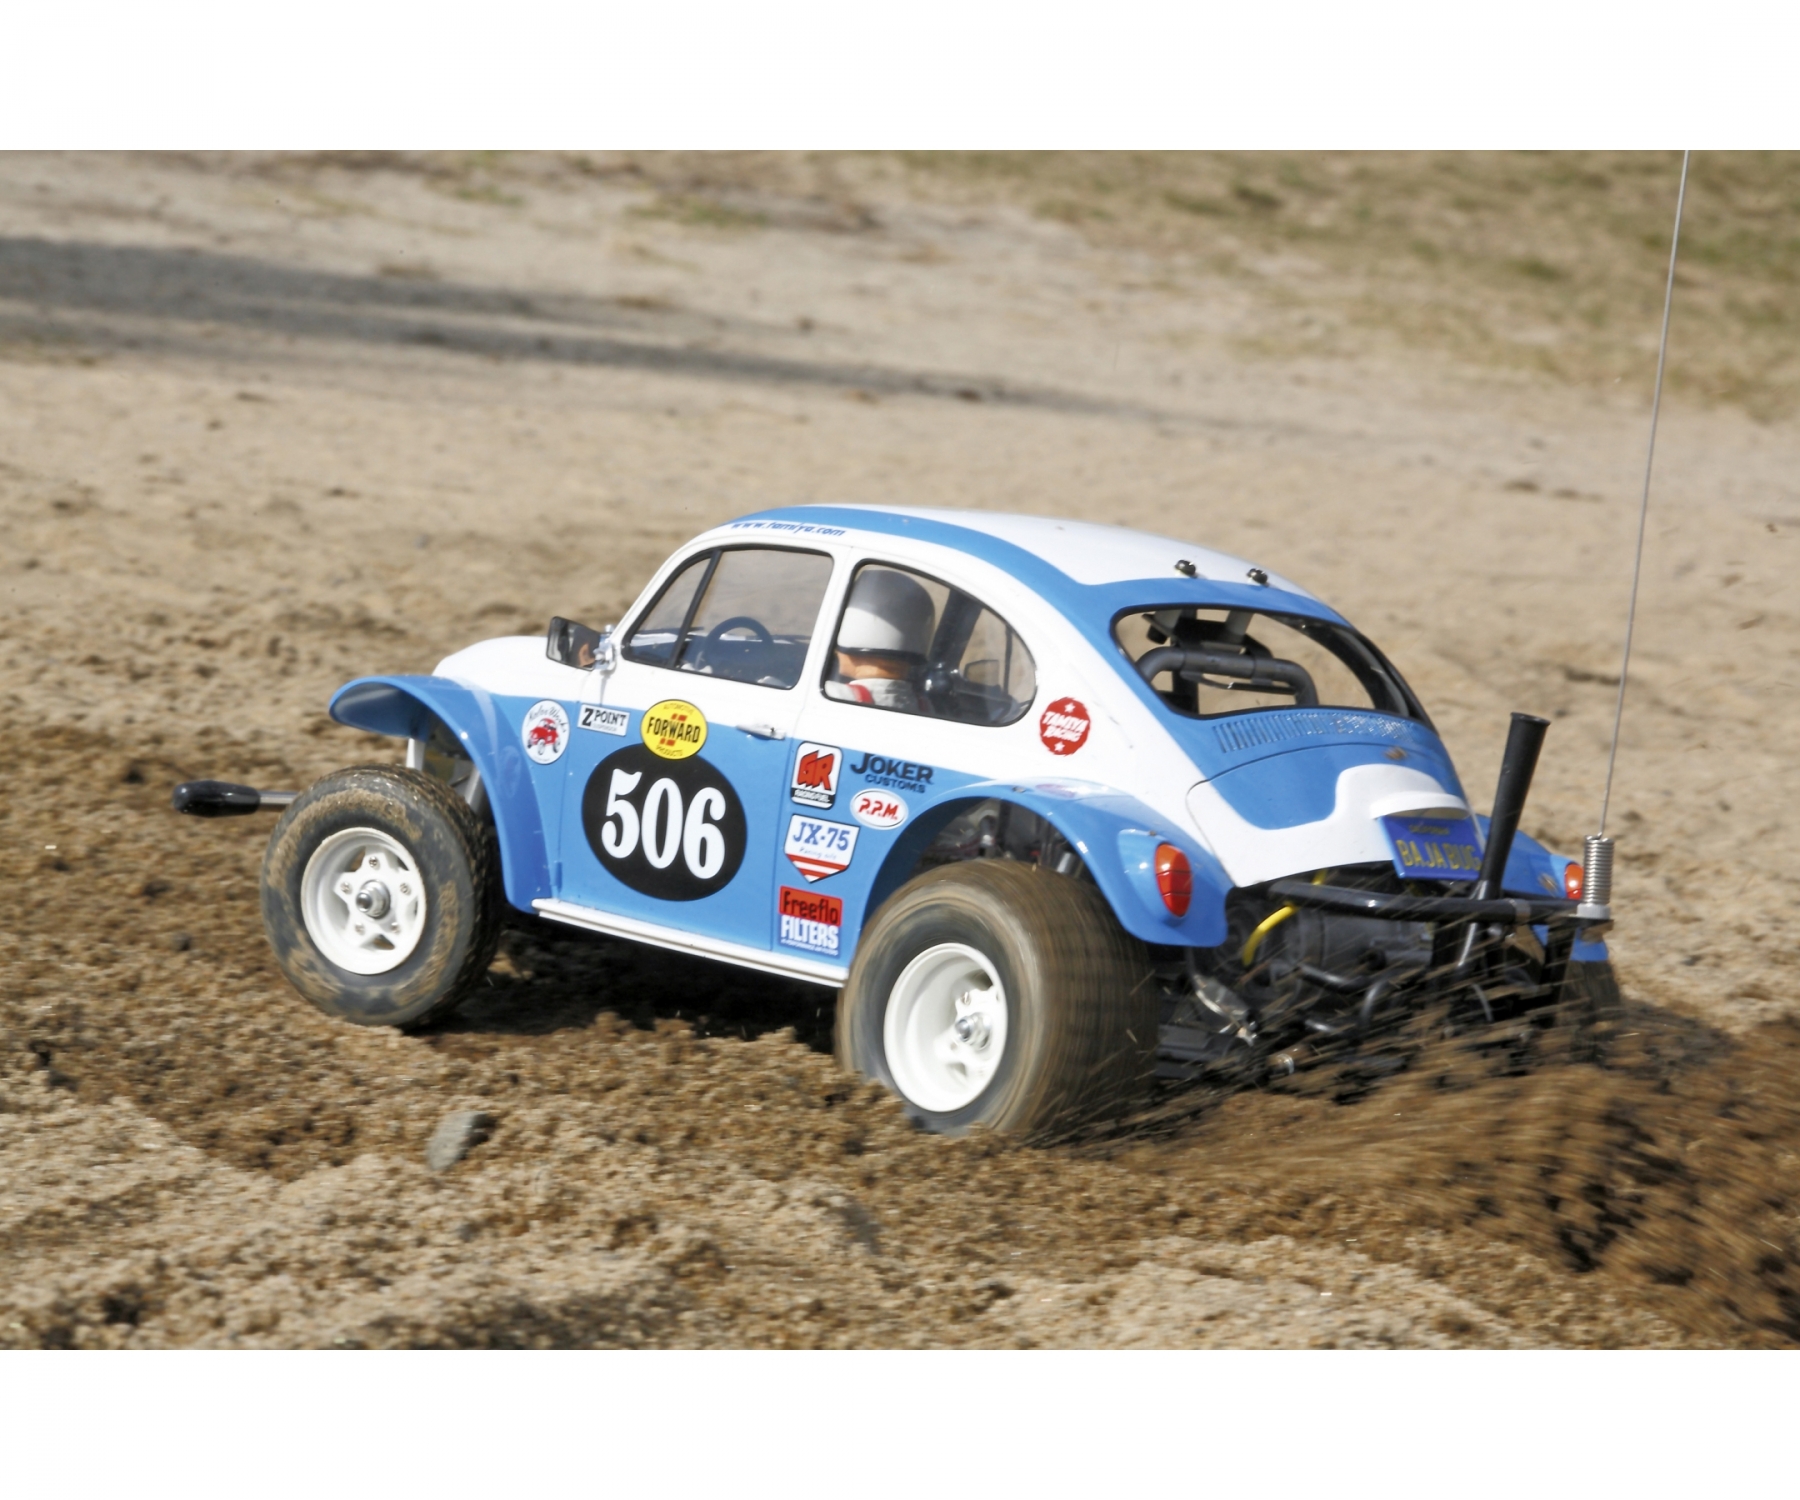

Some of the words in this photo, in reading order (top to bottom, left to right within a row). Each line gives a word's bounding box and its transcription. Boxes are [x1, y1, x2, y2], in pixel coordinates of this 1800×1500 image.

[731, 521, 846, 536] www.tamiya.com
[581, 707, 595, 727] Z
[594, 709, 627, 727] POINT
[646, 716, 701, 743] FORWARD
[1041, 711, 1090, 733] TAMIYA
[850, 752, 935, 785] JOKER
[864, 773, 927, 794] CUSTOMS
[601, 768, 727, 880] 506
[793, 821, 851, 851] JX-75
[1395, 839, 1449, 870] BAJA
[780, 914, 839, 950] FILTERS
